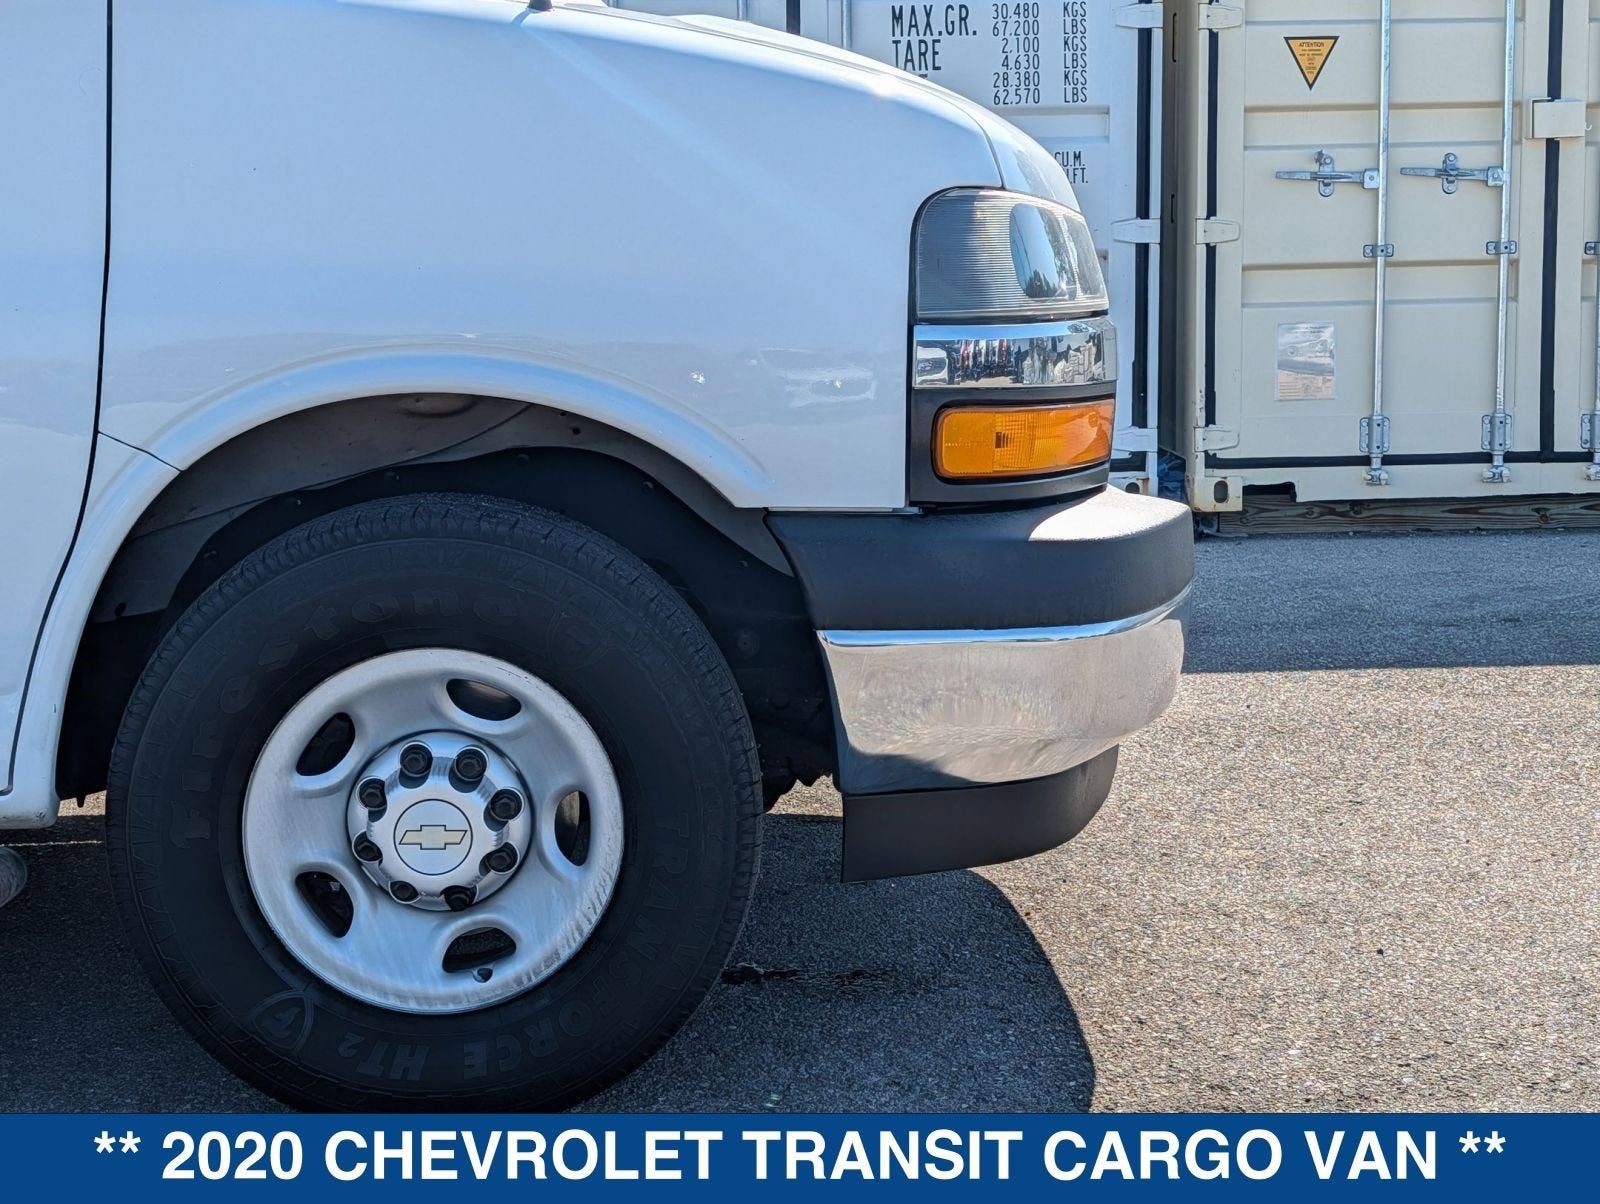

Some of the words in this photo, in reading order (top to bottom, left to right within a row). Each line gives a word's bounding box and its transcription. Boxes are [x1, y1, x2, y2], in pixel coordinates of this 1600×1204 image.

[891, 4, 977, 37] MAX.GR.
[992, 3, 1040, 20] 30.480
[1063, 2, 1087, 18] KGS
[992, 20, 1040, 37] 67.200
[1063, 19, 1087, 35] LBS
[892, 39, 942, 71] TARE
[1001, 37, 1040, 54] 2.100
[1063, 36, 1087, 52] KGS
[1001, 54, 1040, 71] 4.630
[1063, 53, 1087, 69] LBS
[992, 72, 1040, 88] 28.380
[1063, 70, 1088, 86] KGS
[993, 88, 1041, 105] 62.570
[1063, 87, 1088, 103] LBS
